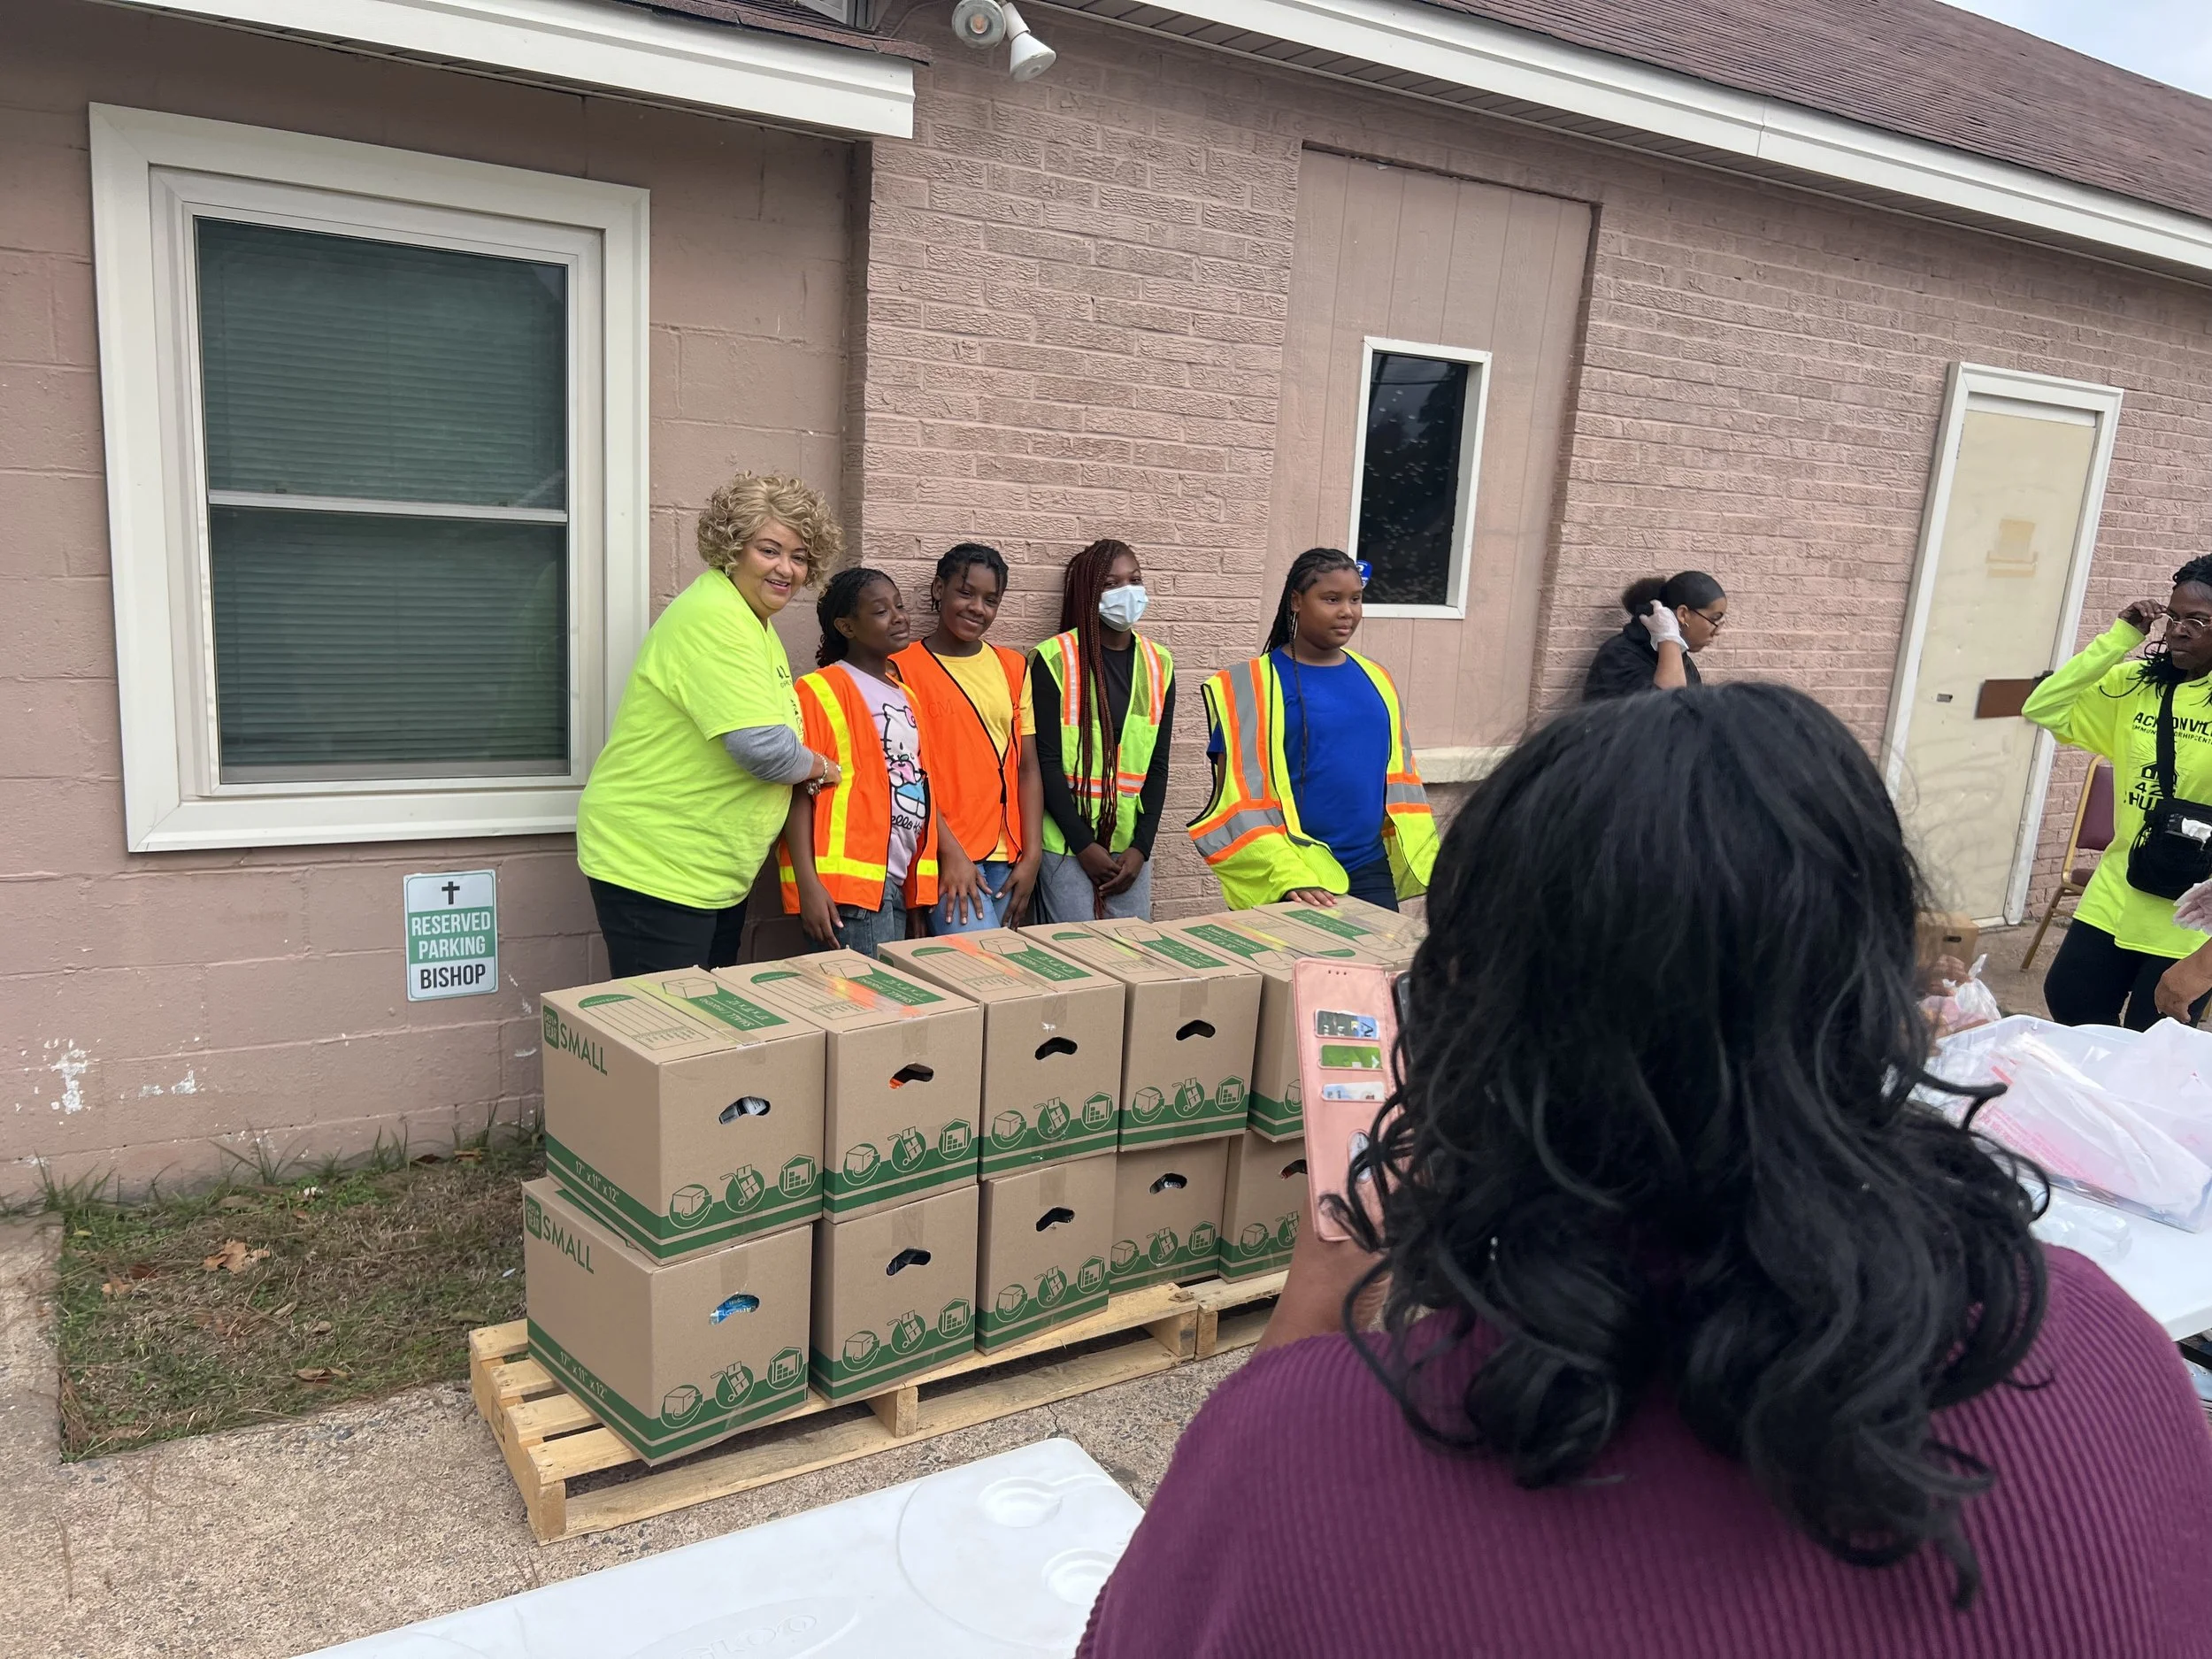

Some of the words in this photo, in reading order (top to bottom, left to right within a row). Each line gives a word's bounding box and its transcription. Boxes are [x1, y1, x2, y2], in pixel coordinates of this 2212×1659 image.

[892, 815, 913, 830] ello
[411, 911, 491, 936] RESERVED
[419, 935, 486, 960] PARKING
[420, 964, 486, 989] BISHOP
[560, 1023, 607, 1076] SMALL
[543, 1215, 594, 1274] SMALL
